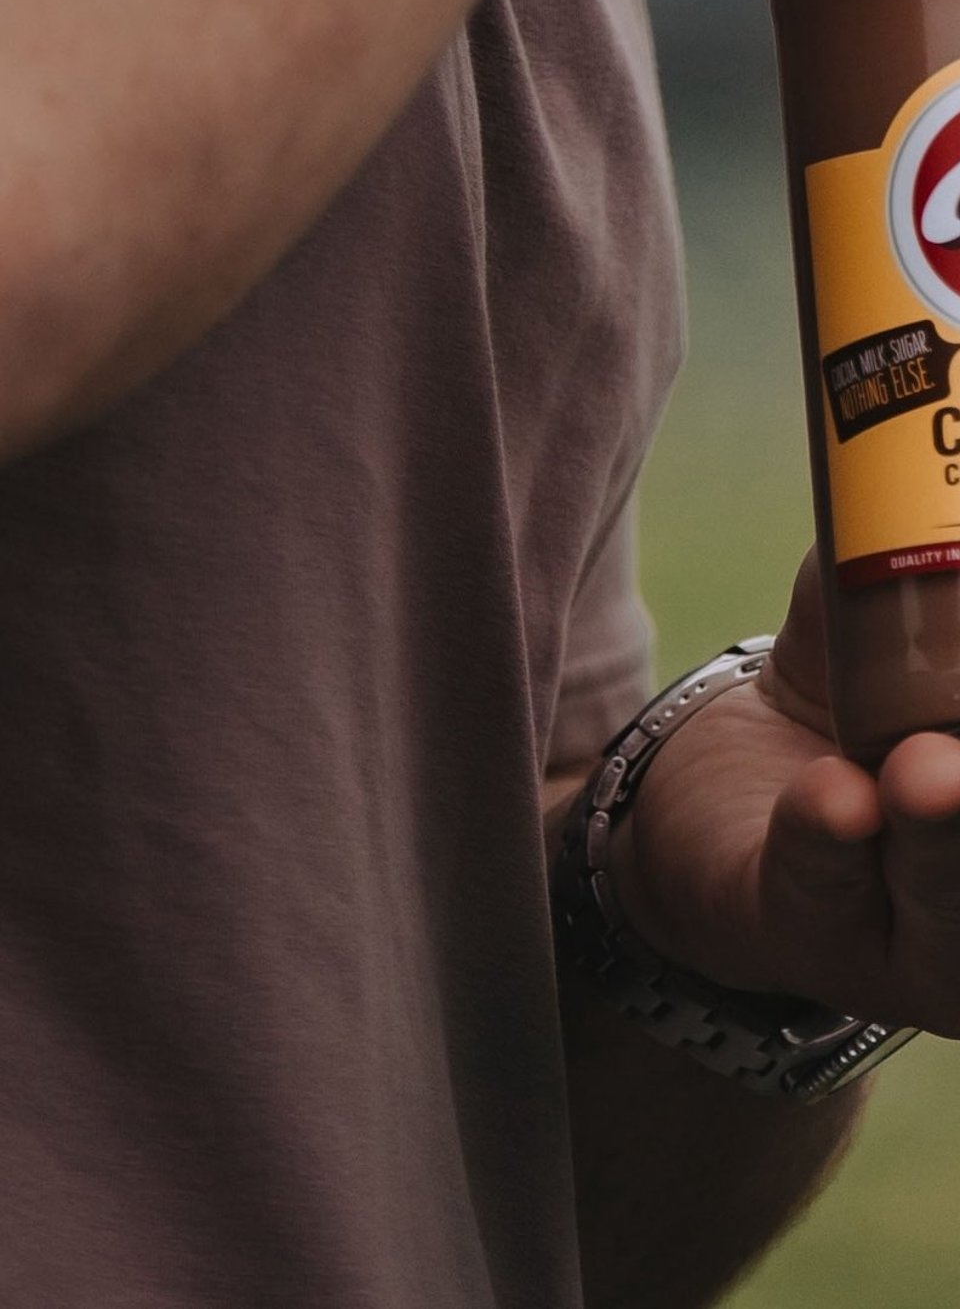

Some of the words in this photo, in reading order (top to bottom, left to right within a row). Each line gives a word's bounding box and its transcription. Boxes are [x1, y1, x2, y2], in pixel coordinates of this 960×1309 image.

[840, 372, 889, 420] NOTHING
[890, 357, 935, 399] ELSE.
[890, 550, 942, 570] QUALITY
